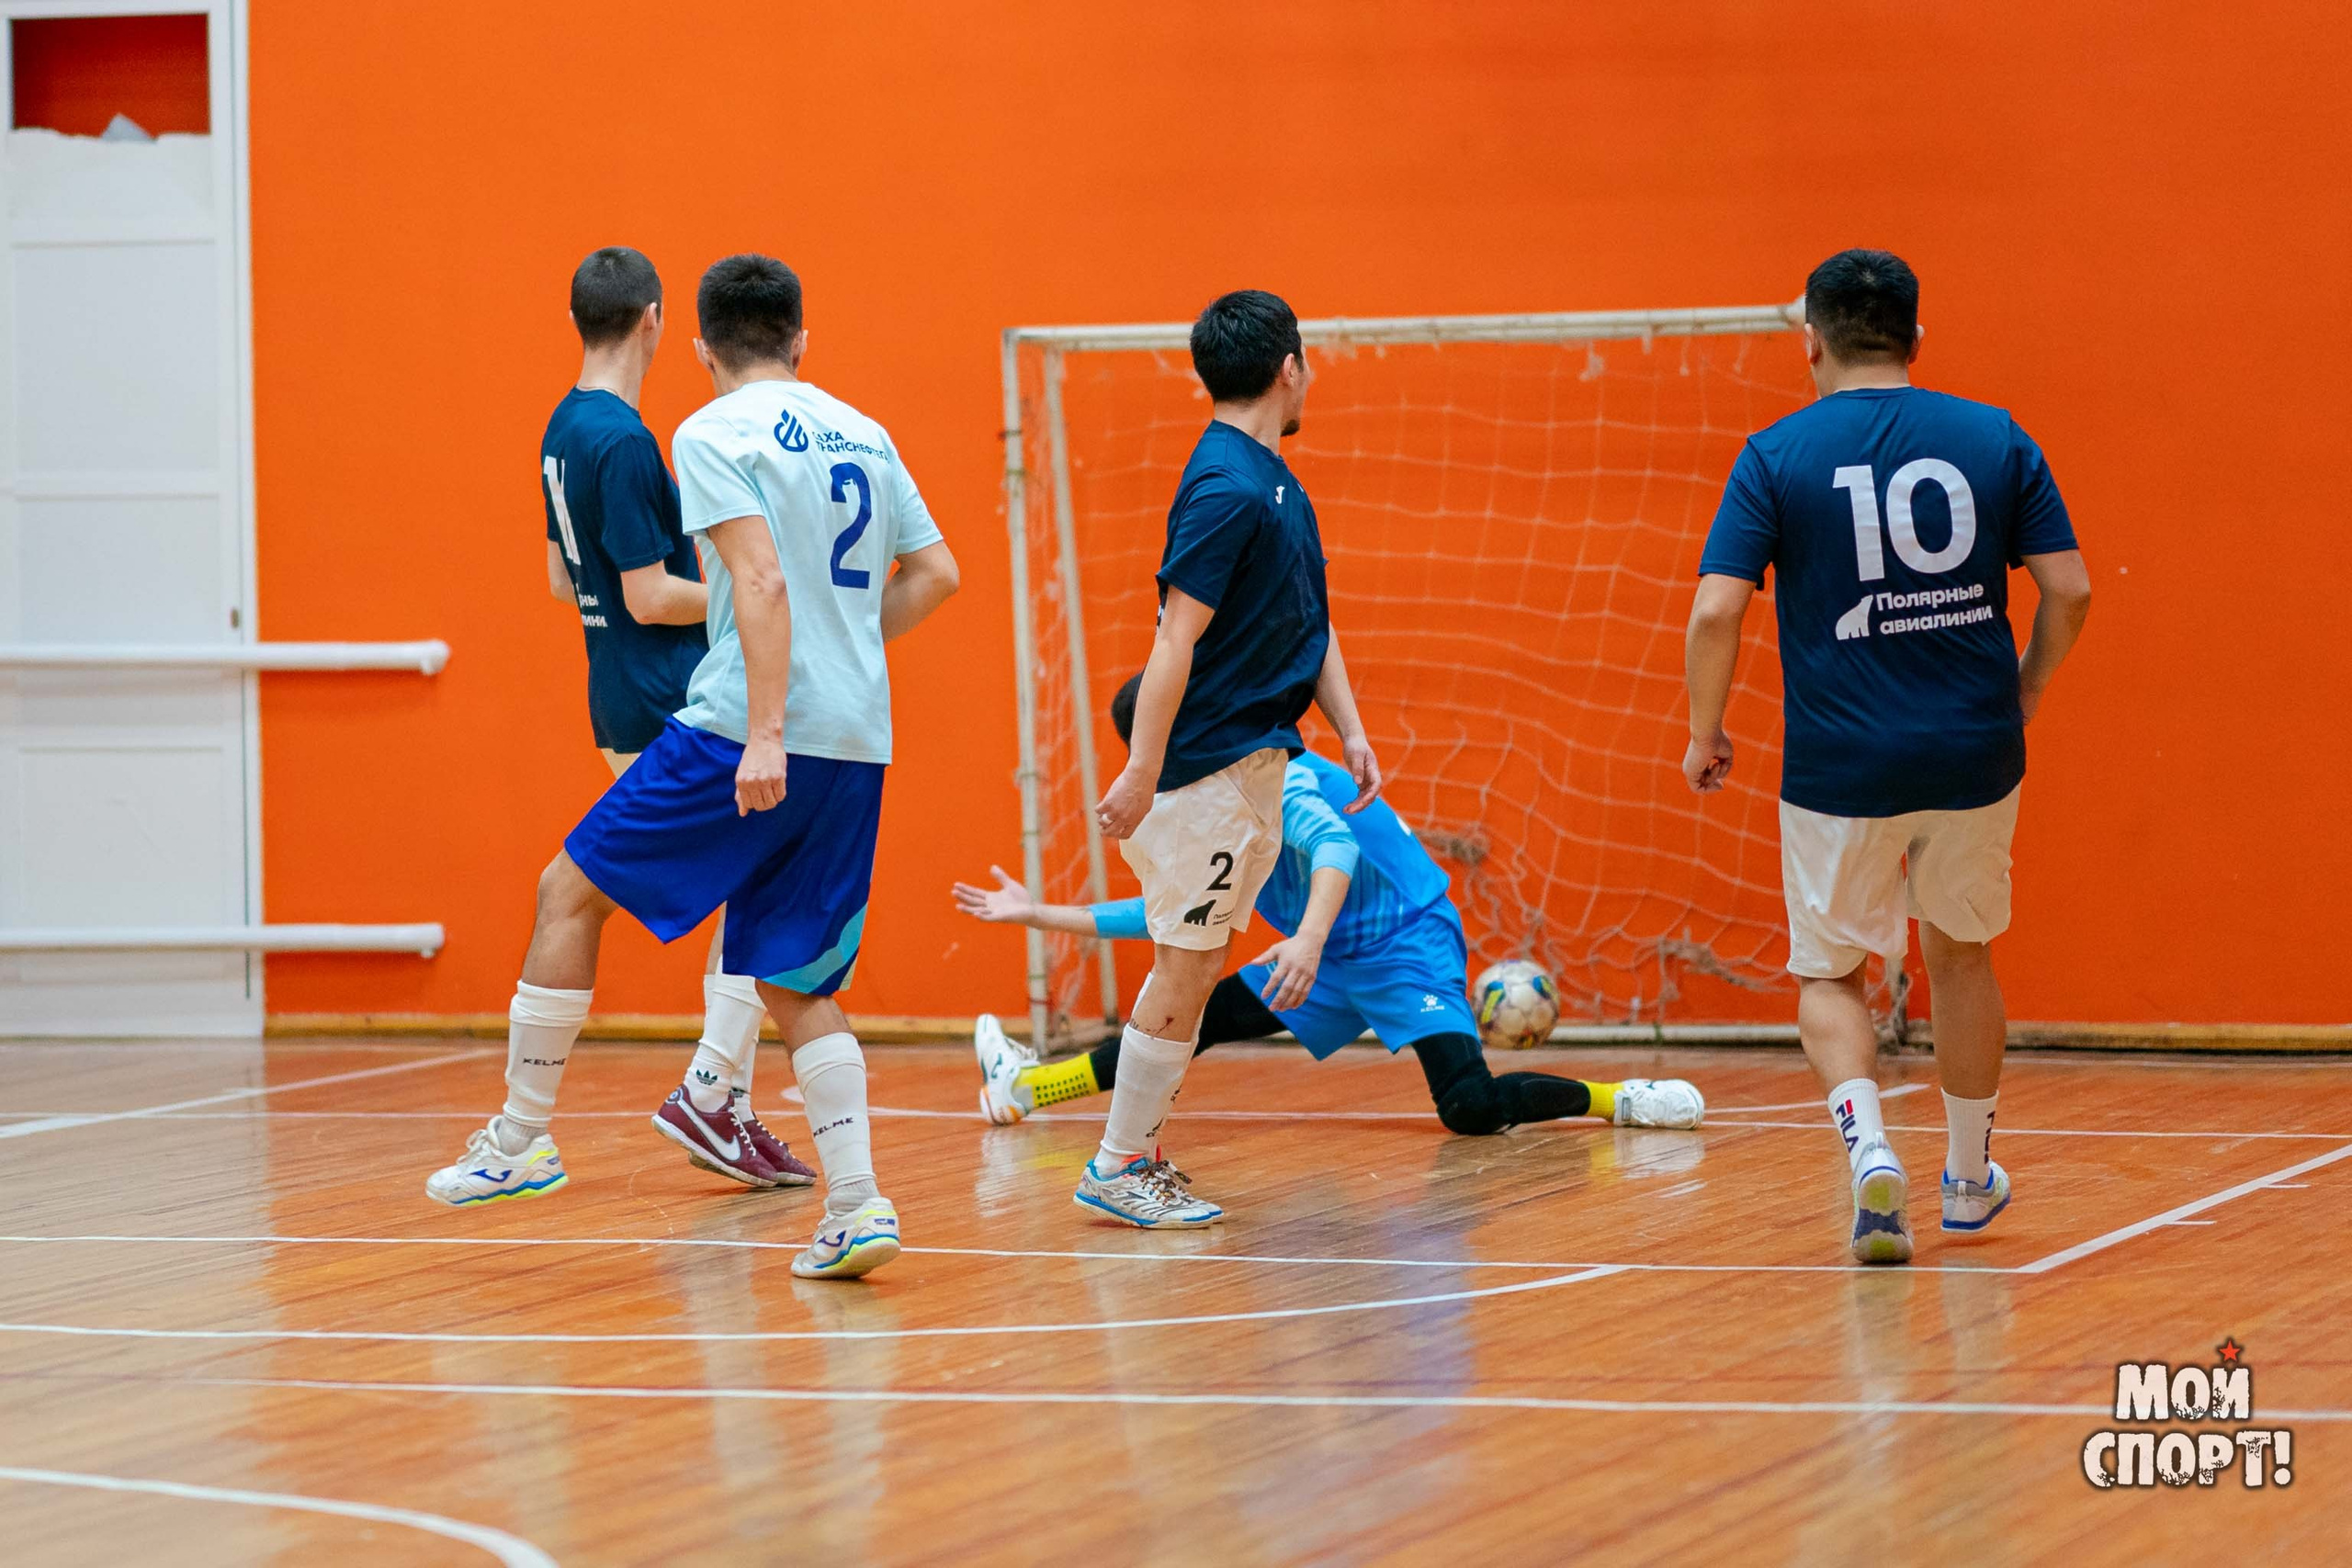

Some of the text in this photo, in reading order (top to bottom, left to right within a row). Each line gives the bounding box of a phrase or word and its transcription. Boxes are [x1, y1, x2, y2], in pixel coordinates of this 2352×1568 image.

[830, 462, 872, 590] 2
[1833, 458, 1976, 581] 10
[1876, 583, 1984, 611] Полярные
[1880, 605, 1993, 635] авиалинии
[1205, 852, 1234, 890] 2
[1836, 1099, 1860, 1154] FILA
